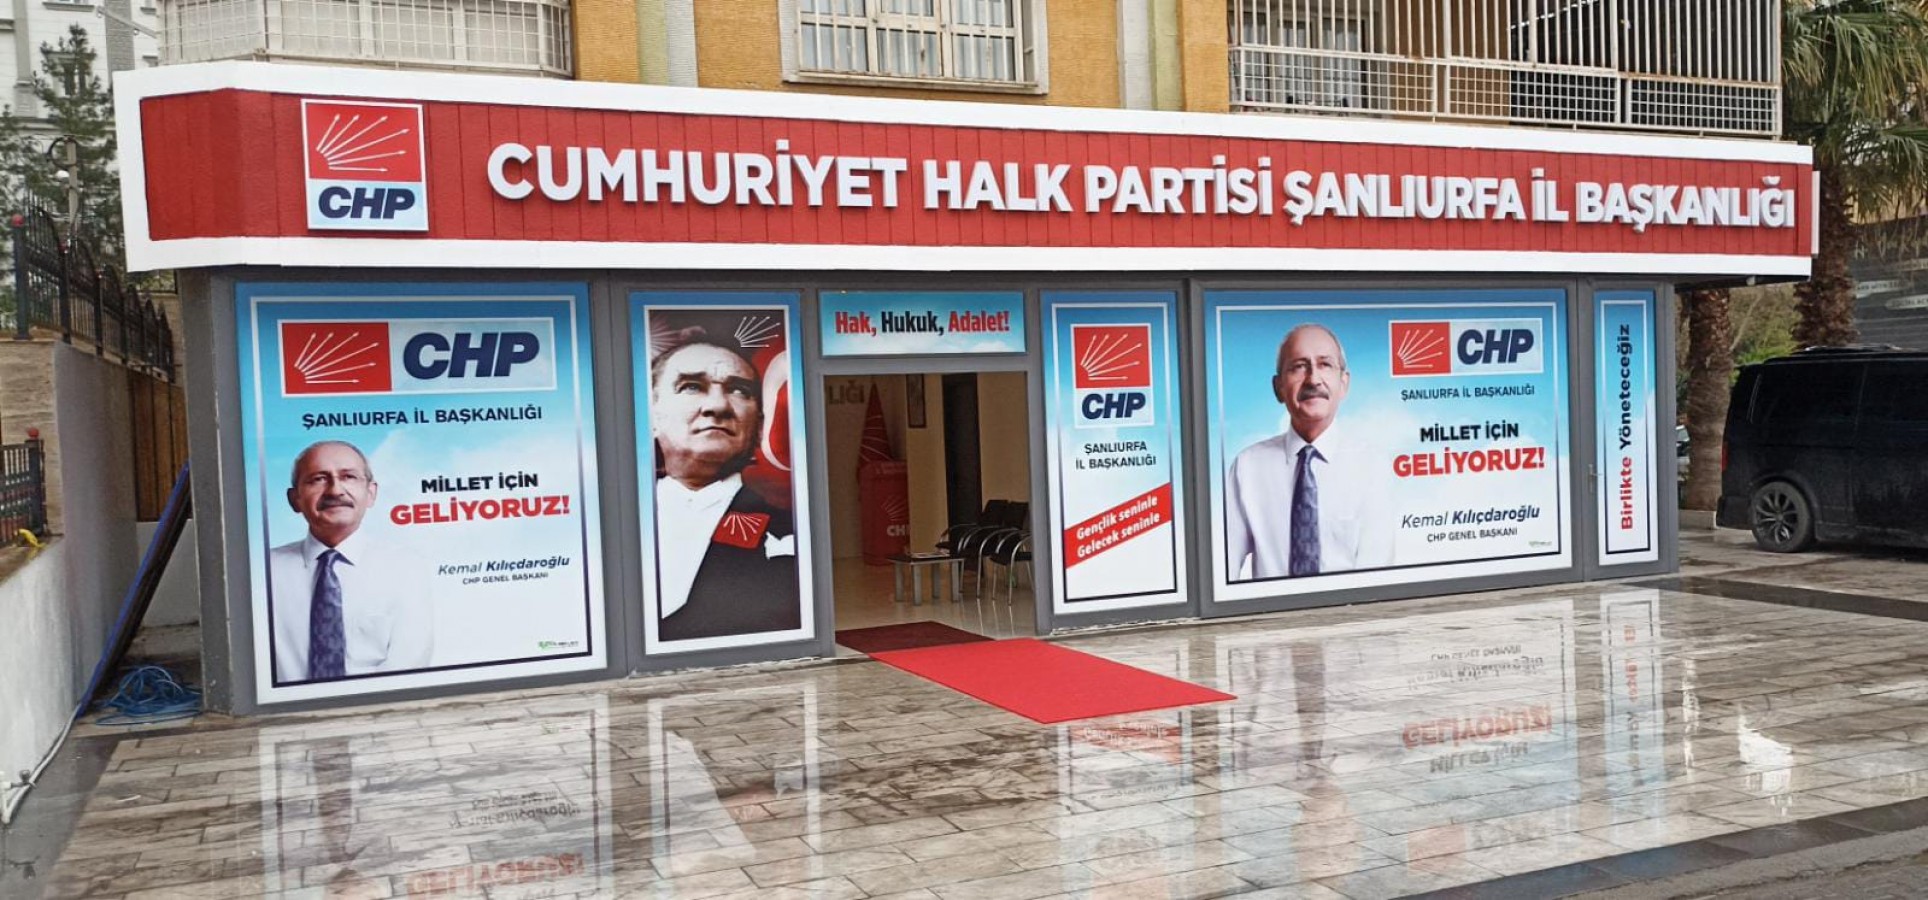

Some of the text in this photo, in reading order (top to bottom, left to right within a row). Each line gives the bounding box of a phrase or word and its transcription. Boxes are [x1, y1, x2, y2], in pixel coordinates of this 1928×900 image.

[487, 139, 1795, 232] CUMHURİYET HALK PARTİSİ ŞANLIURFA İL BAŞKANLIĞI
[318, 186, 416, 219] CHP
[835, 310, 1010, 337] Hak, Hukuk, Adalet!
[403, 331, 540, 380] CHP
[1457, 328, 1534, 365] CHP
[1400, 383, 1535, 401] ŞANLIURFA İL BAŞKANLIĞI
[302, 404, 542, 430] ŞANLIURFA İL BAŞKANLIĞI
[1081, 392, 1146, 420] CHP
[1420, 420, 1519, 442] MİLLET İÇİN
[1617, 324, 1633, 529] Birlikte Yöneteceğiz
[1084, 441, 1147, 455] ŞANLIURFA
[1076, 454, 1156, 470] İL BAŞKANLIĞI
[1393, 447, 1545, 478] GELİYORUZ!
[421, 471, 538, 493] MİLLET İÇİN
[390, 495, 570, 525] GELİYORUZ!
[1076, 495, 1158, 540] Gençlik seninle
[1401, 505, 1541, 529] Kemal Kılıçdaroğlu
[1077, 512, 1160, 558] Gelecek seninle
[1427, 527, 1518, 543] CHP GENEL BAŞKANI
[438, 556, 570, 575] Kemal Kılıçdaroğlu
